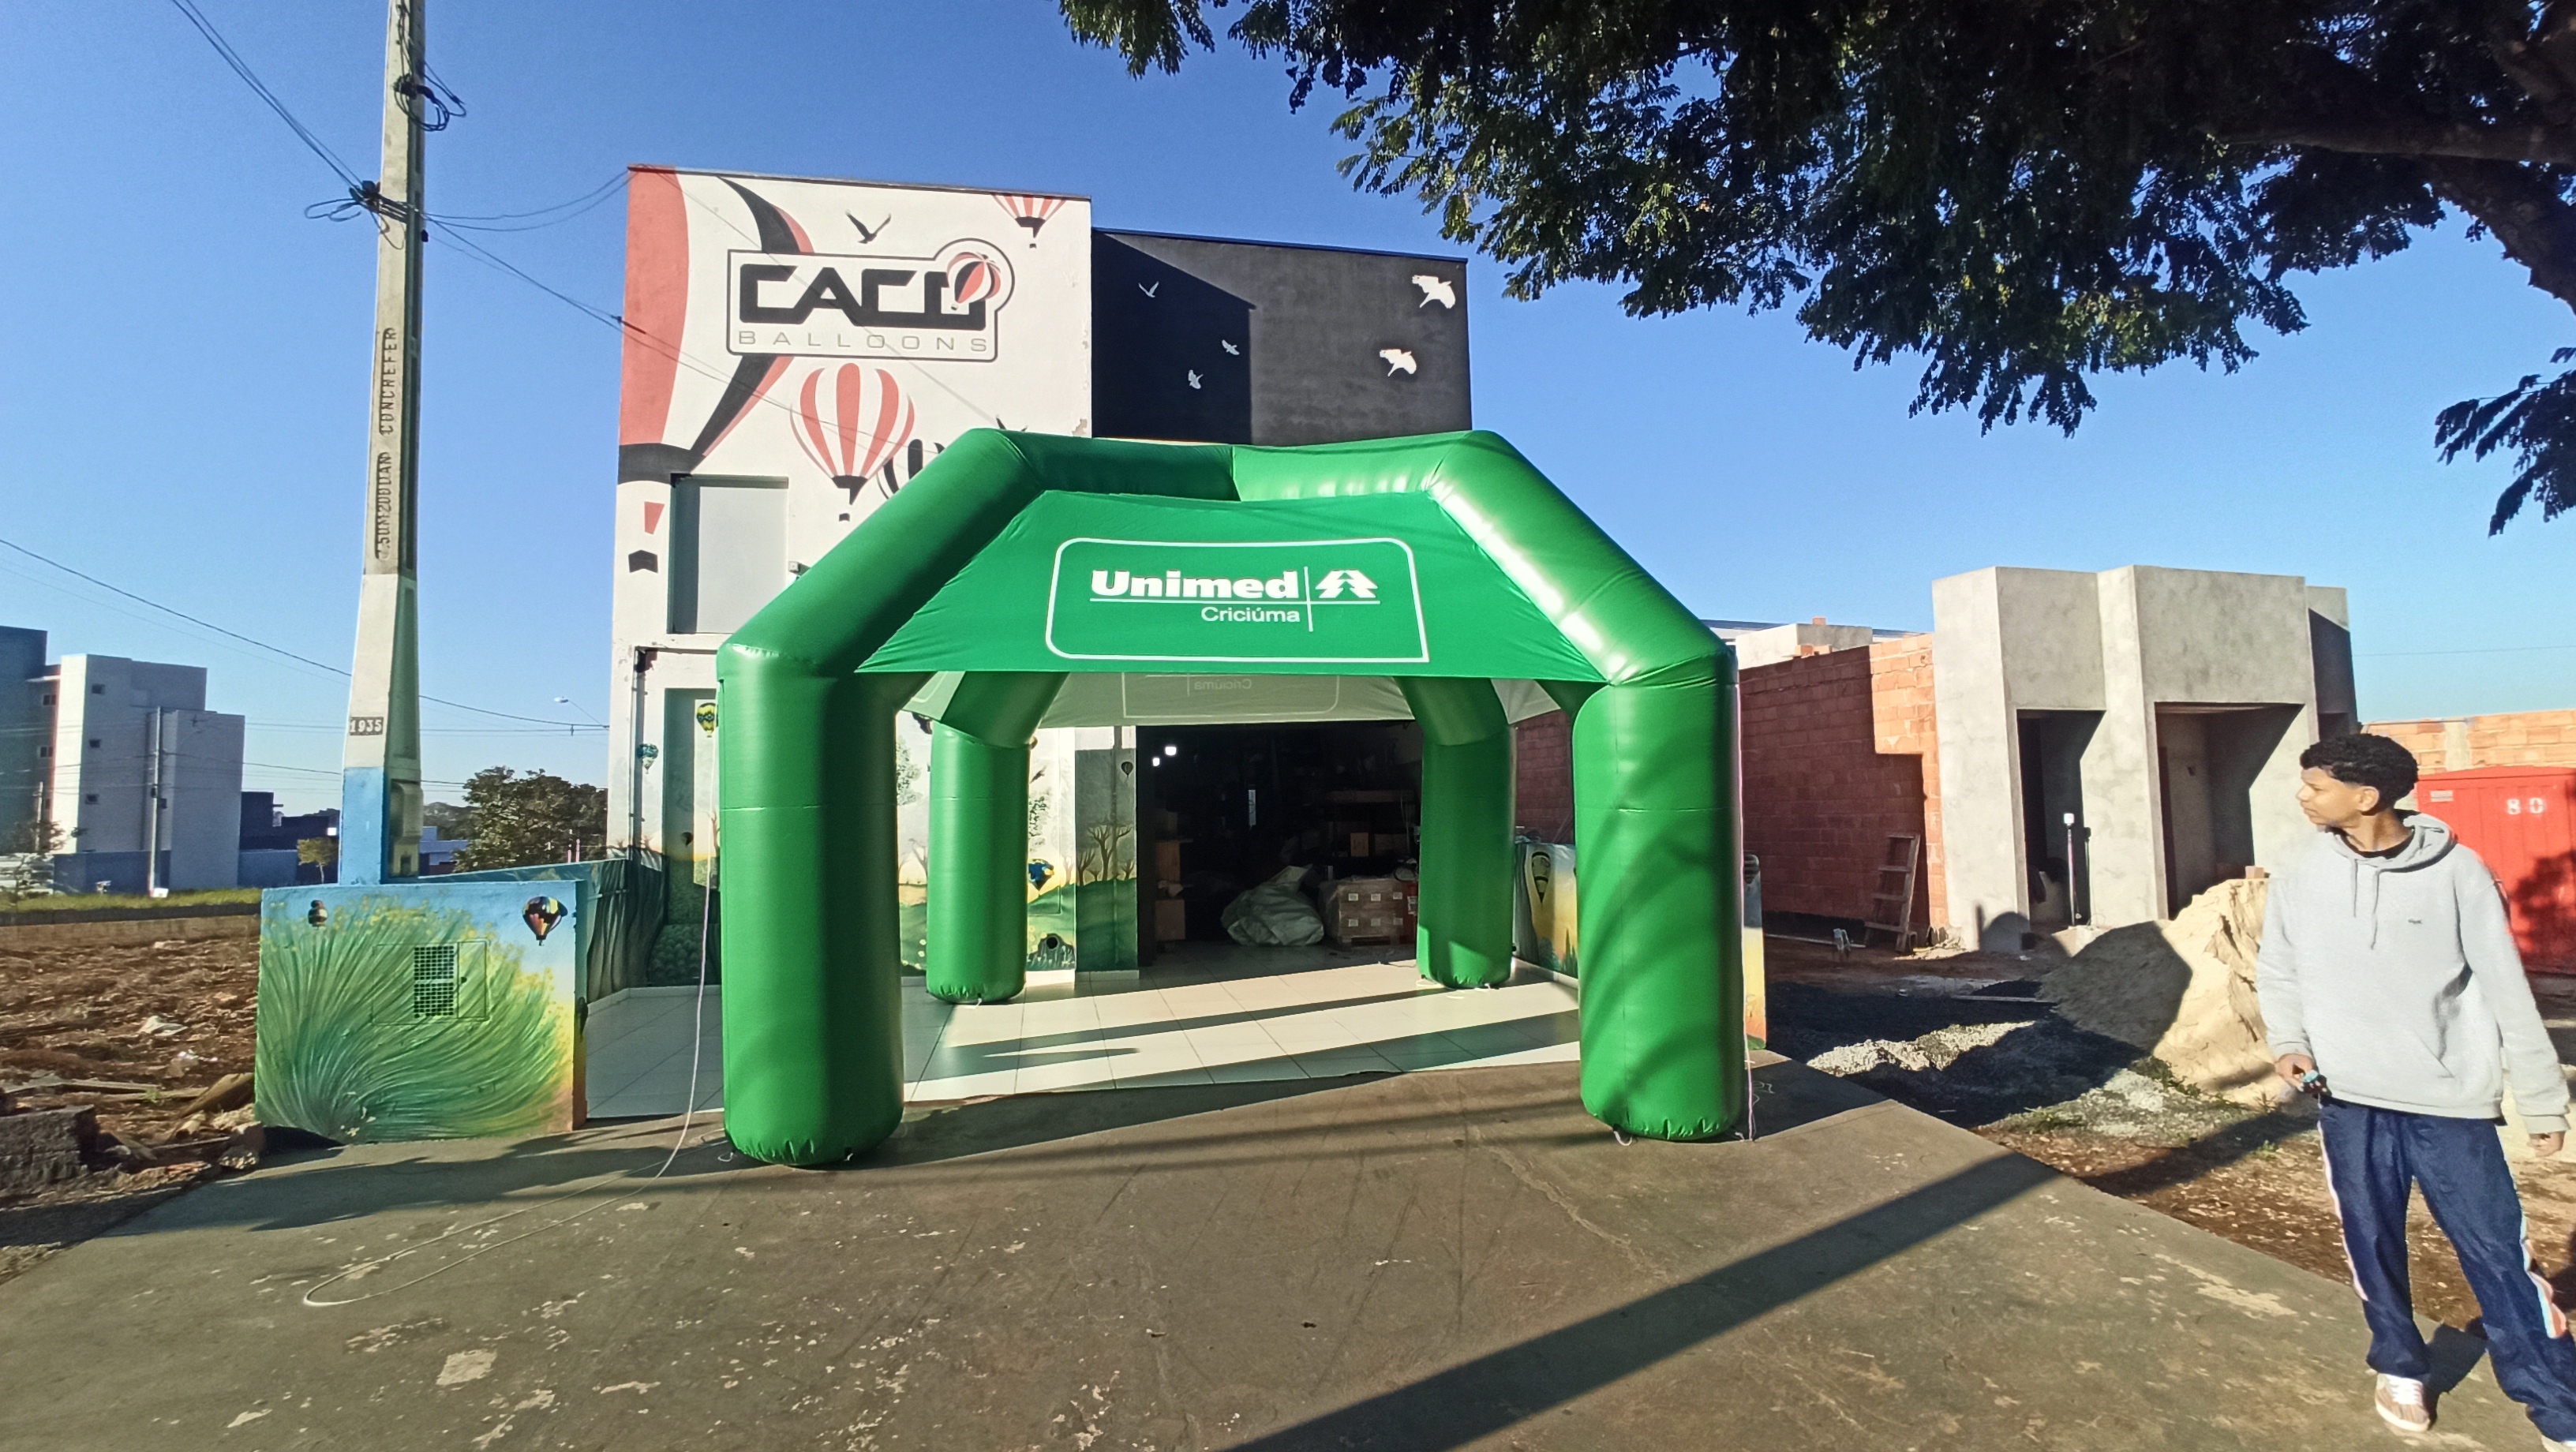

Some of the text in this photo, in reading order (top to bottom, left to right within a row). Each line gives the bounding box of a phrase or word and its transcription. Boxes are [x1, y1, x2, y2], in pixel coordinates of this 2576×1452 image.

[739, 331, 988, 352] BALLOONS
[380, 327, 397, 435] CONCREFER
[1091, 570, 1298, 598] Unimed
[1201, 606, 1300, 623] Criciúma
[350, 719, 382, 733] 1935
